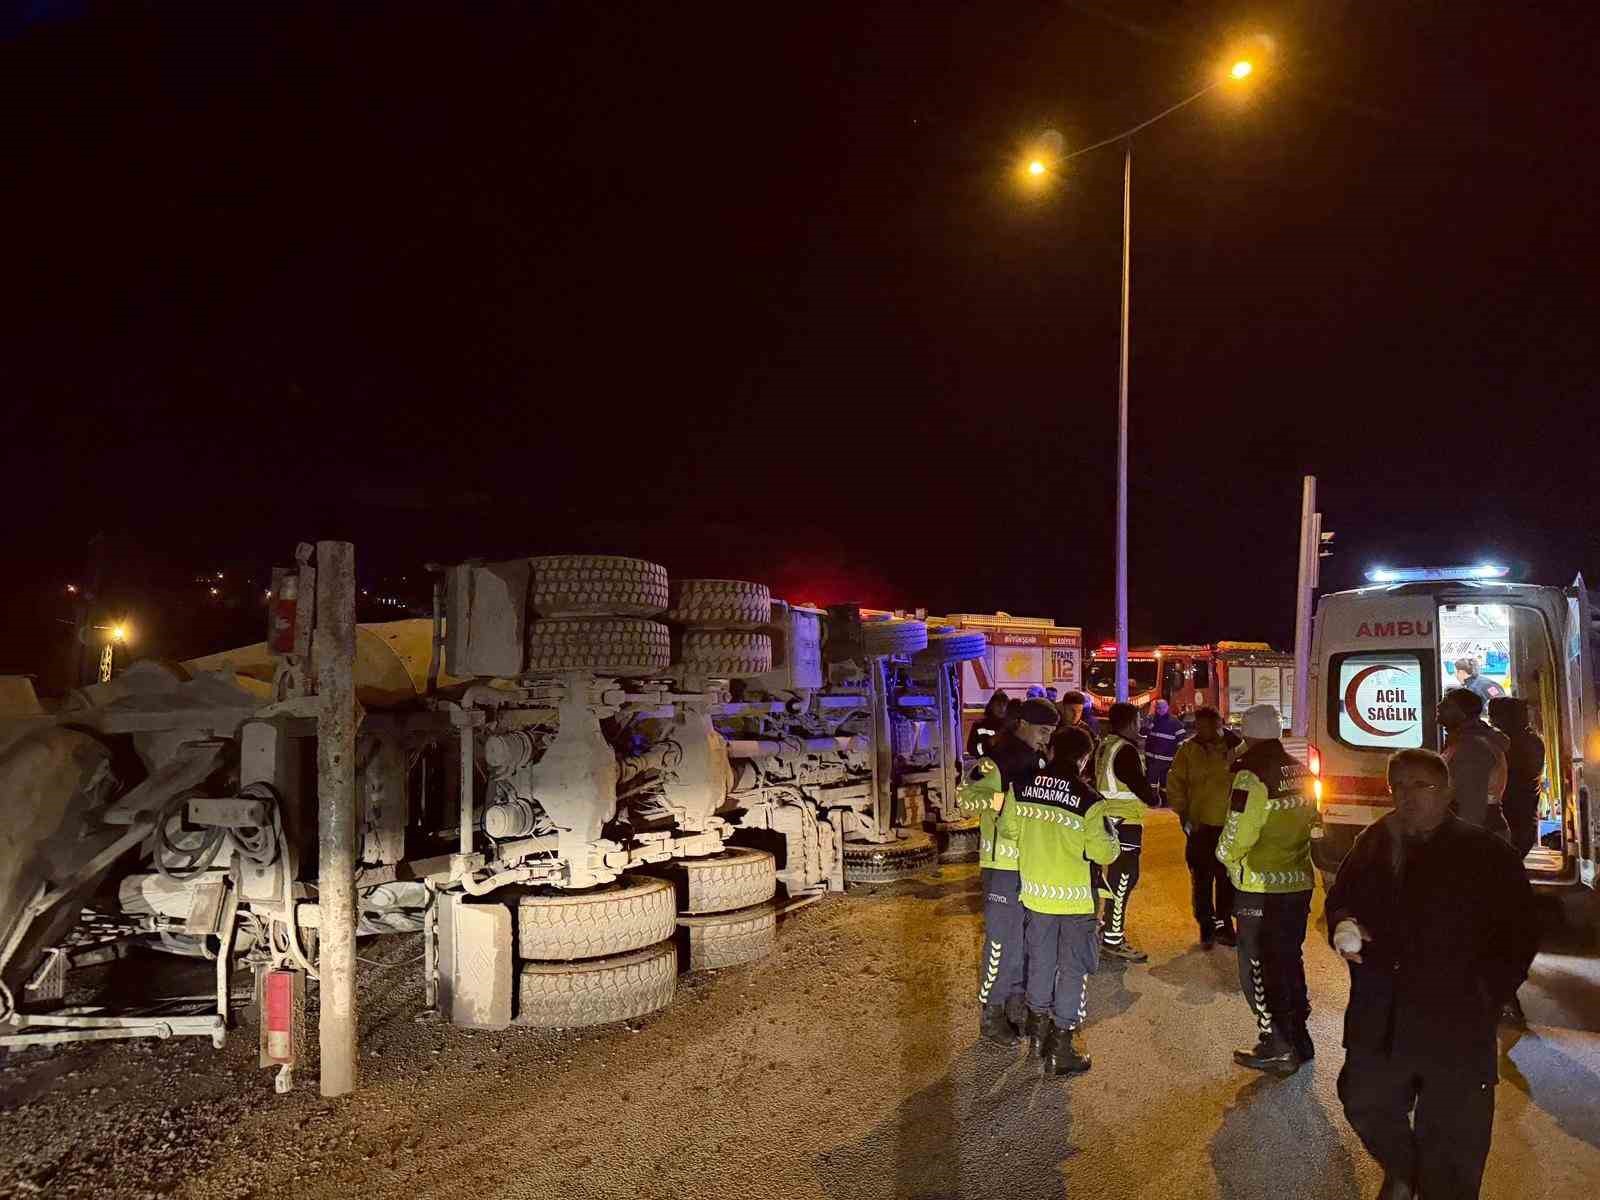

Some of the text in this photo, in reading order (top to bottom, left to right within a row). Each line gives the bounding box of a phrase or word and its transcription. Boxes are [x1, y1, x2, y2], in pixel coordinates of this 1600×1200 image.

[1355, 621, 1433, 637] AMBU
[1376, 688, 1407, 703] ACİL
[1367, 705, 1418, 721] SAĞLIK
[1034, 775, 1071, 792] OTOYOL
[1021, 785, 1081, 809] JANDARMASI
